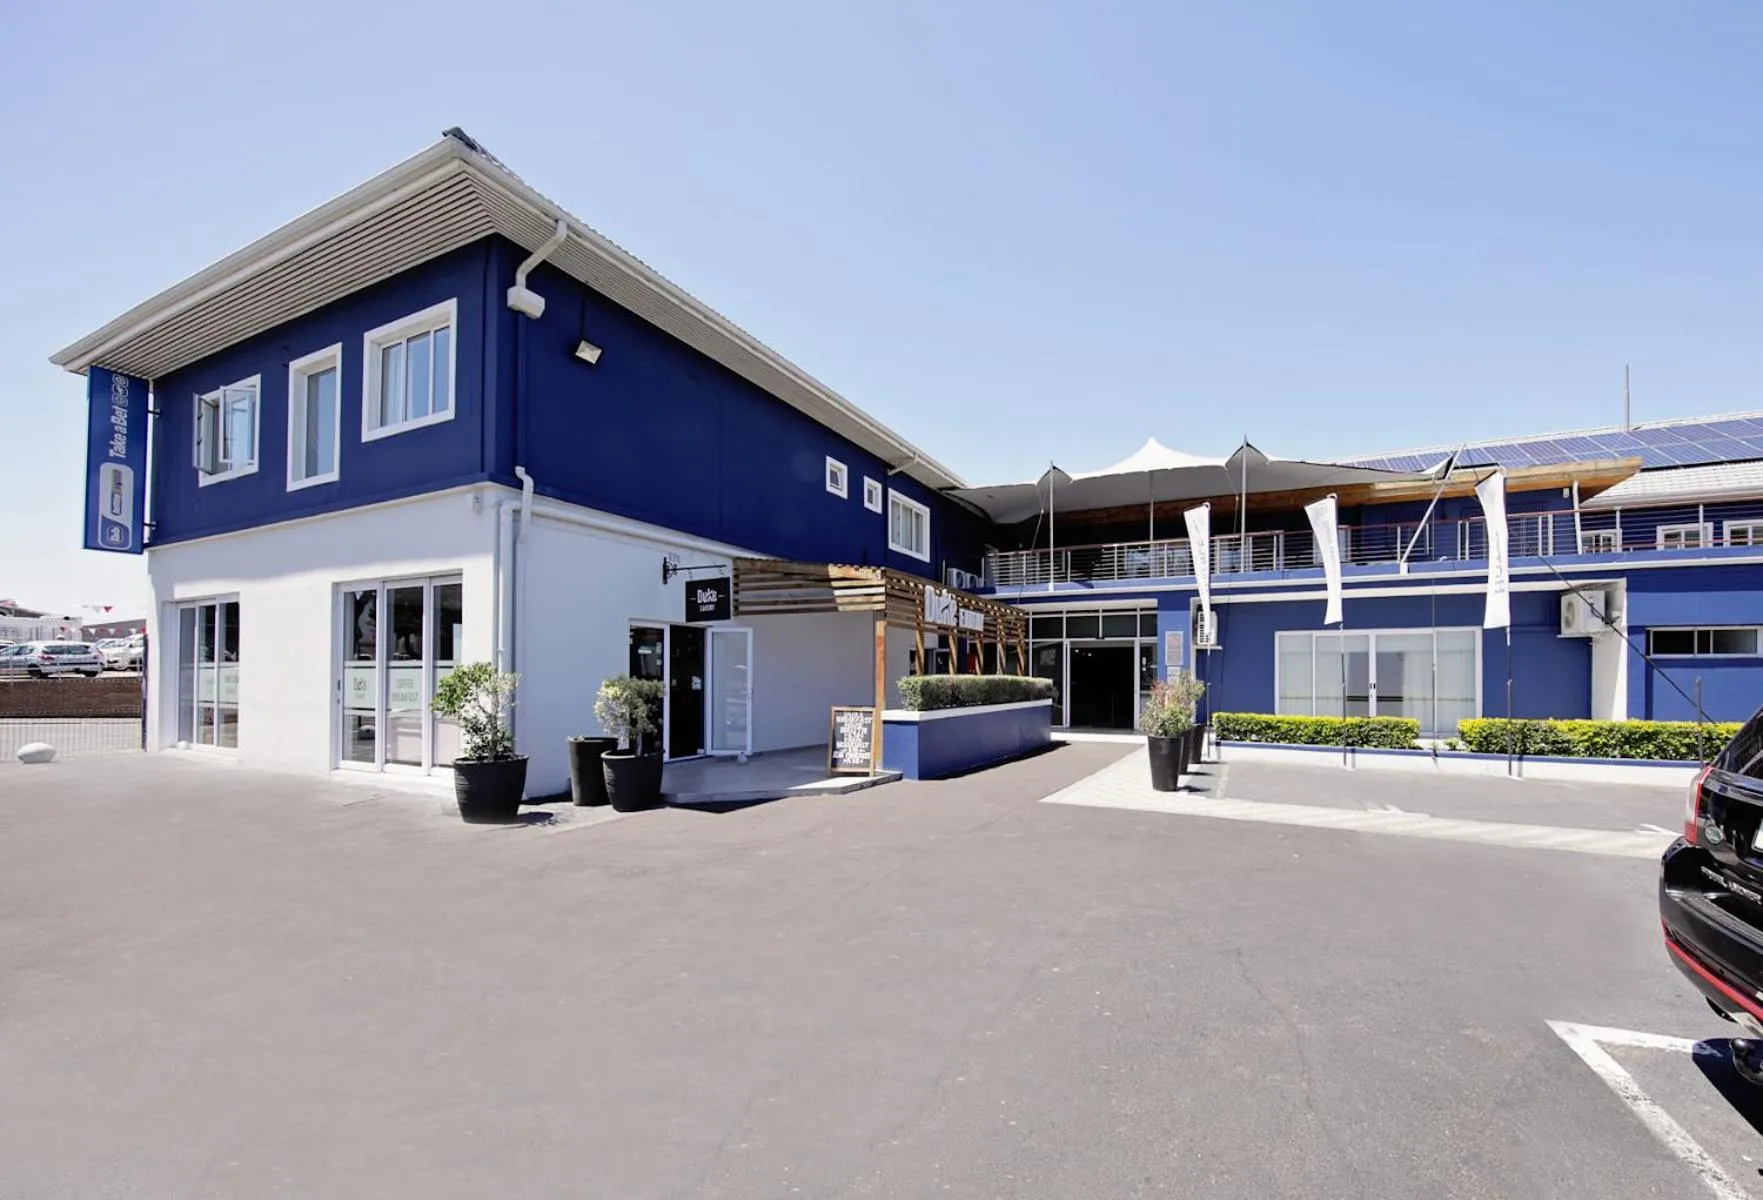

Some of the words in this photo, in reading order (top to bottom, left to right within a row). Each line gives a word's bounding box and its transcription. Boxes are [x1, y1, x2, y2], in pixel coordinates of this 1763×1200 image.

[110, 405, 128, 427] Bet
[114, 425, 127, 434] a
[109, 433, 127, 459] Take
